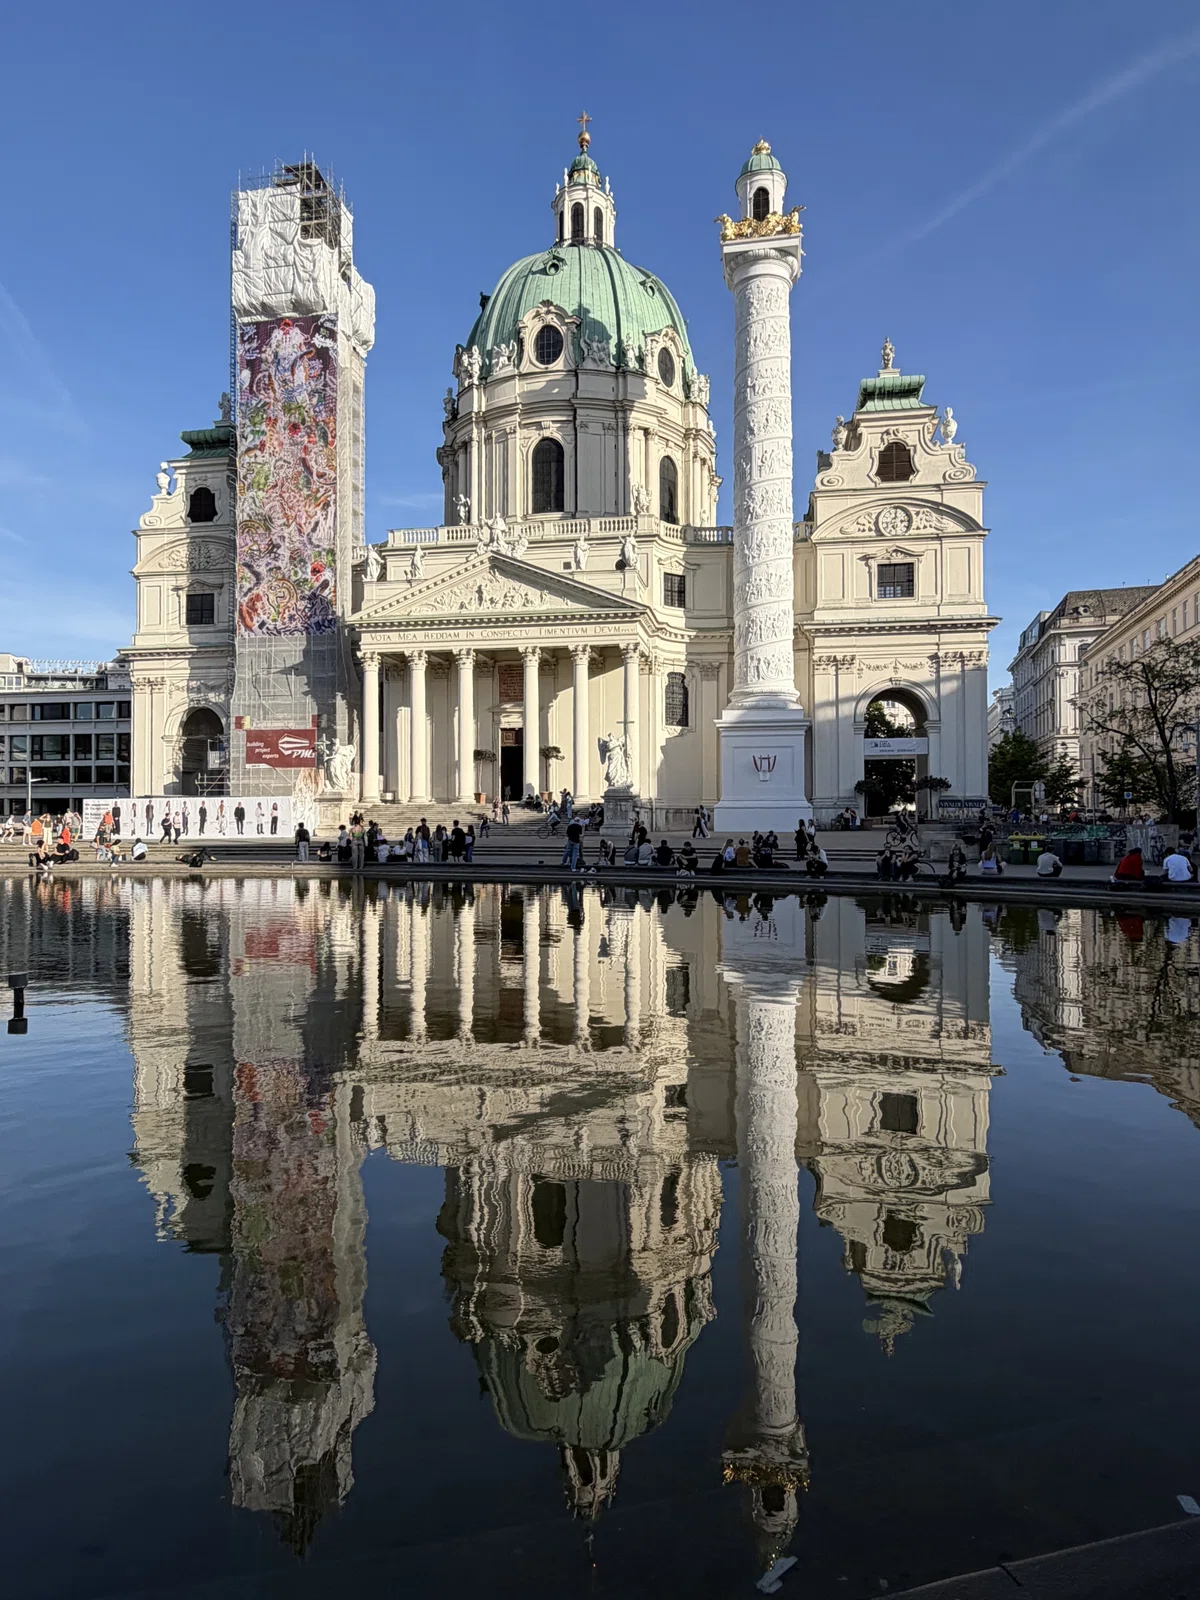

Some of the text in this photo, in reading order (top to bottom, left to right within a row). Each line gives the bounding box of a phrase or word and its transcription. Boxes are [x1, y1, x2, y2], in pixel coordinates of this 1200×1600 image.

[370, 633, 392, 642] VOTA
[398, 632, 418, 641] MEA
[424, 631, 460, 640] REDDAM
[466, 630, 475, 639] IN
[480, 629, 531, 638] CONSPECTV
[539, 627, 588, 636] TIMENTIVM
[594, 625, 621, 634] DEVM
